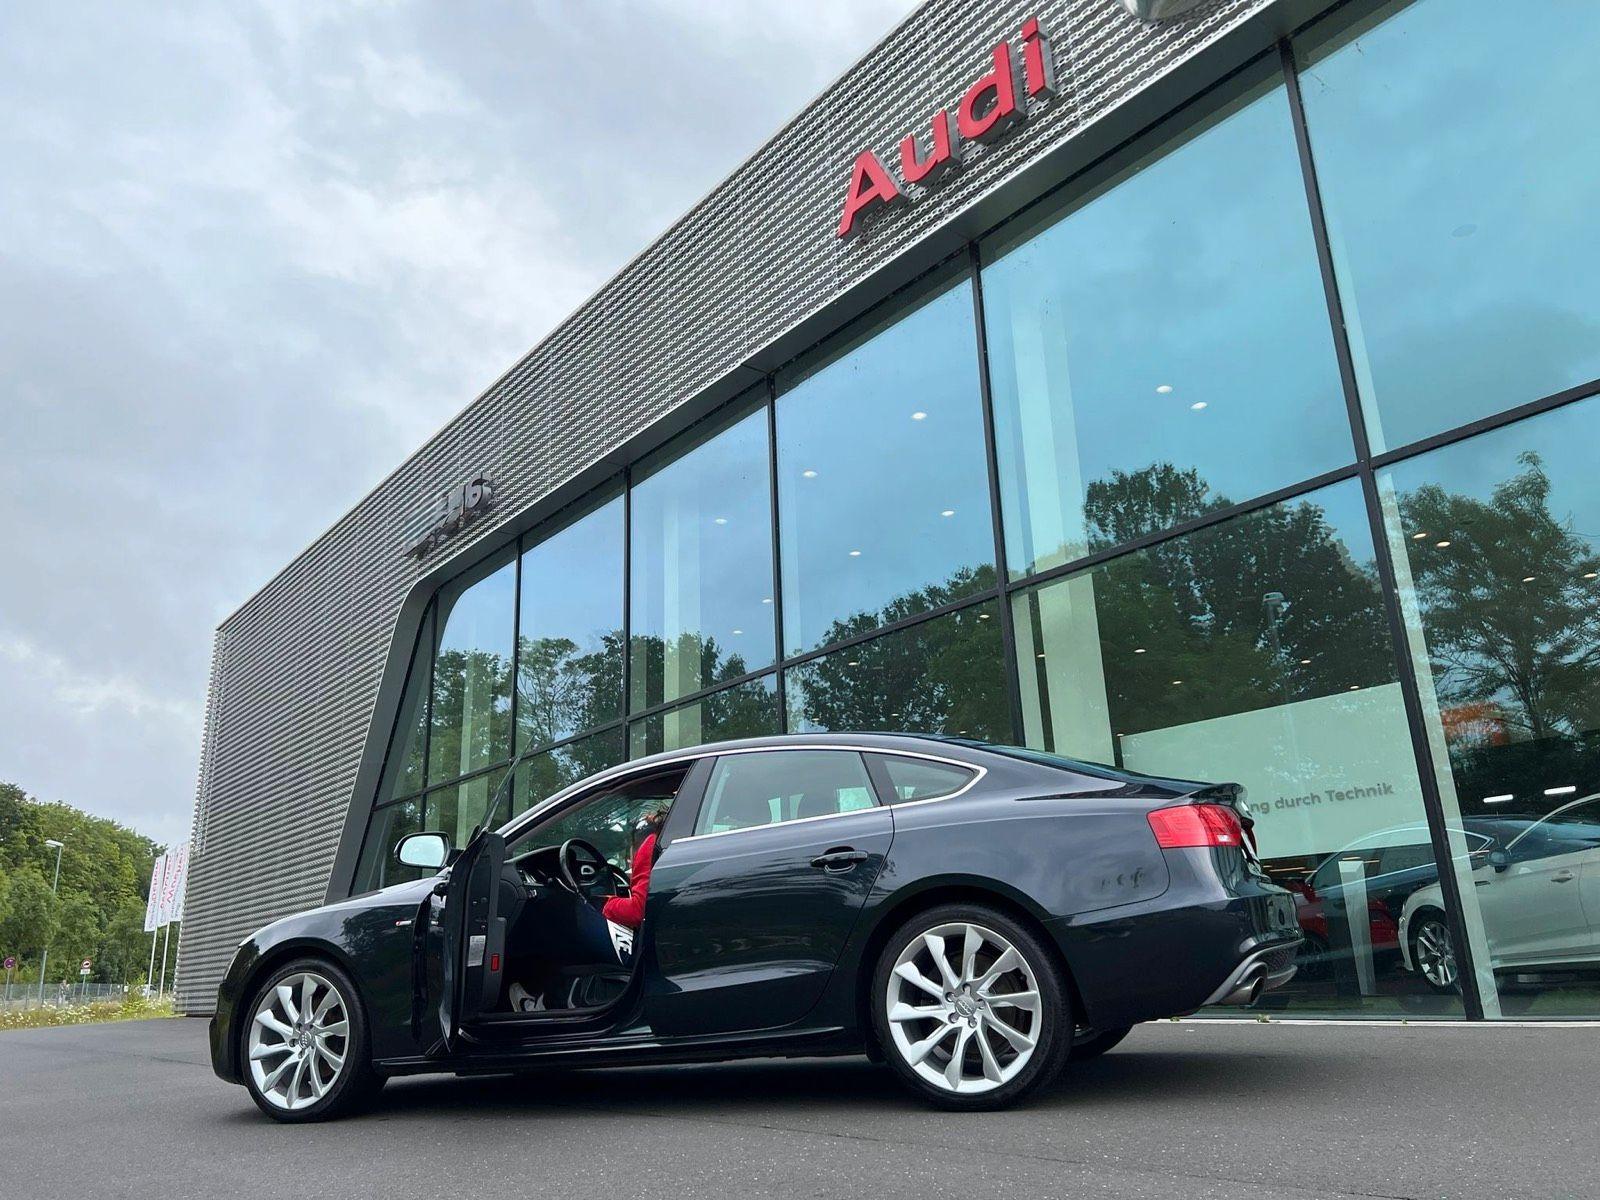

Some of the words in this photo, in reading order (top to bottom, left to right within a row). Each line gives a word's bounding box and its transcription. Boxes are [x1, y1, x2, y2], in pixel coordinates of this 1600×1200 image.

[837, 16, 1048, 238] Audi
[1274, 793, 1321, 810] durch
[1325, 782, 1394, 802] Technik
